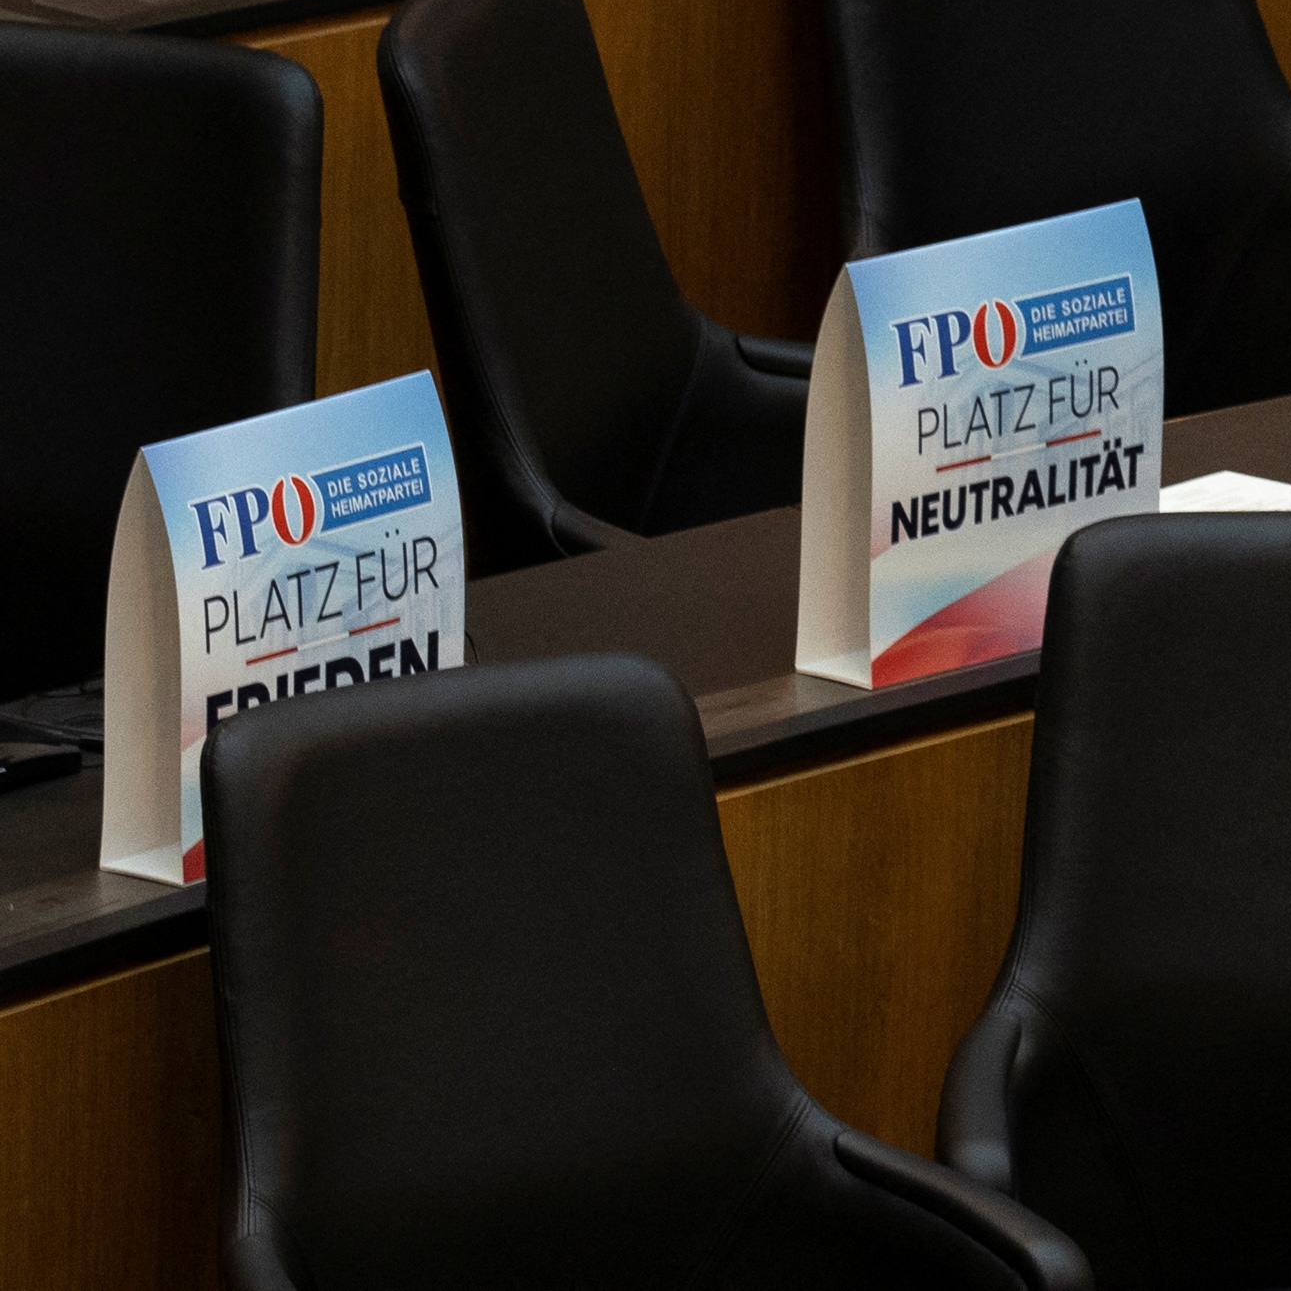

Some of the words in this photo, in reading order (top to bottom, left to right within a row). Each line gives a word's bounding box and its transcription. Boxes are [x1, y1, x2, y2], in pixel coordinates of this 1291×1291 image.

[1030, 301, 1056, 324] DIE
[1061, 287, 1126, 318] SOZIALE
[1032, 308, 1129, 343] HEIMATPARTEI
[918, 384, 1036, 455] PLATZ
[1049, 359, 1120, 425] FÜR
[327, 476, 353, 498] DIE
[357, 457, 421, 490] SOZIALE
[890, 438, 1144, 544] NEUTRALITÄT
[331, 479, 425, 518] HEIMATPARTEI
[204, 561, 343, 654] PLATZ
[356, 528, 439, 610] FÜR
